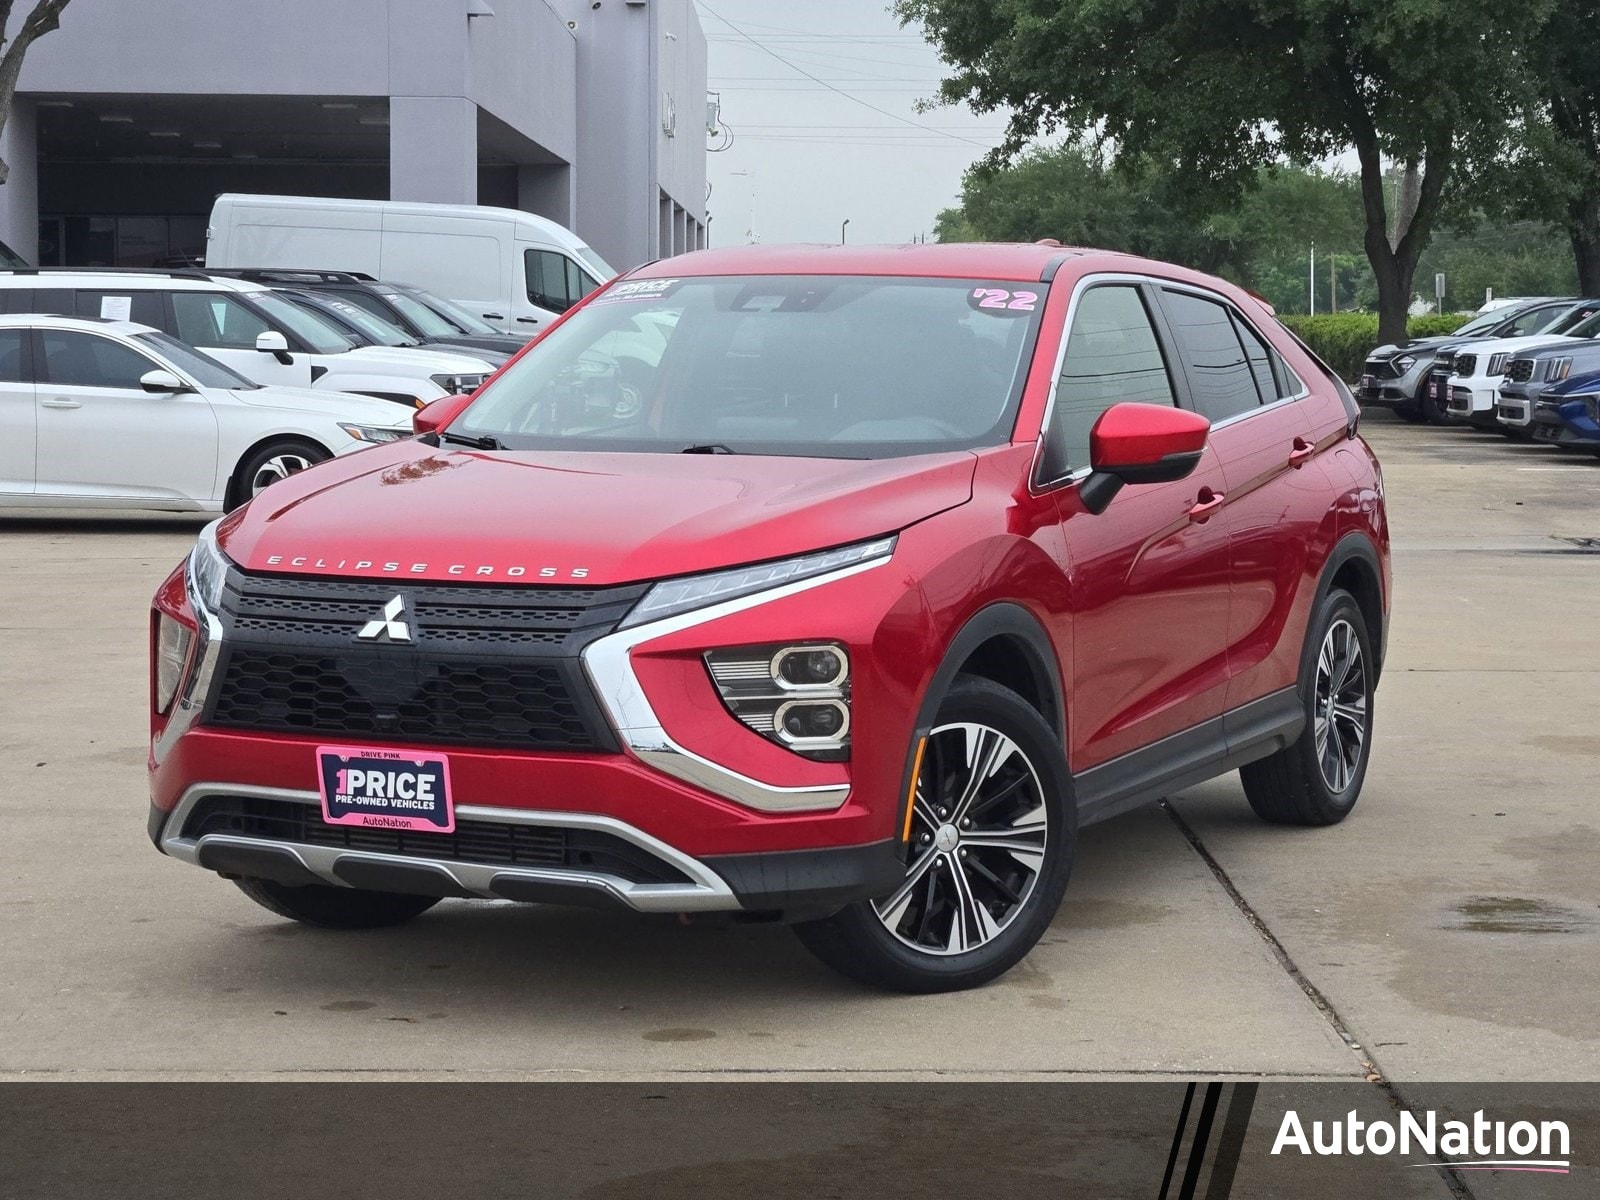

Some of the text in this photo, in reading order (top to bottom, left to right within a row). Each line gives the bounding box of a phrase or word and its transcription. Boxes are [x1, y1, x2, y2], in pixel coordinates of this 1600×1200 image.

[973, 288, 1038, 311] '22
[266, 555, 590, 578] ECLIPSE CROSS
[361, 751, 382, 759] DRIVE
[335, 795, 435, 810] PRE-OWNED VEHICLES
[363, 816, 412, 828] AutoNation
